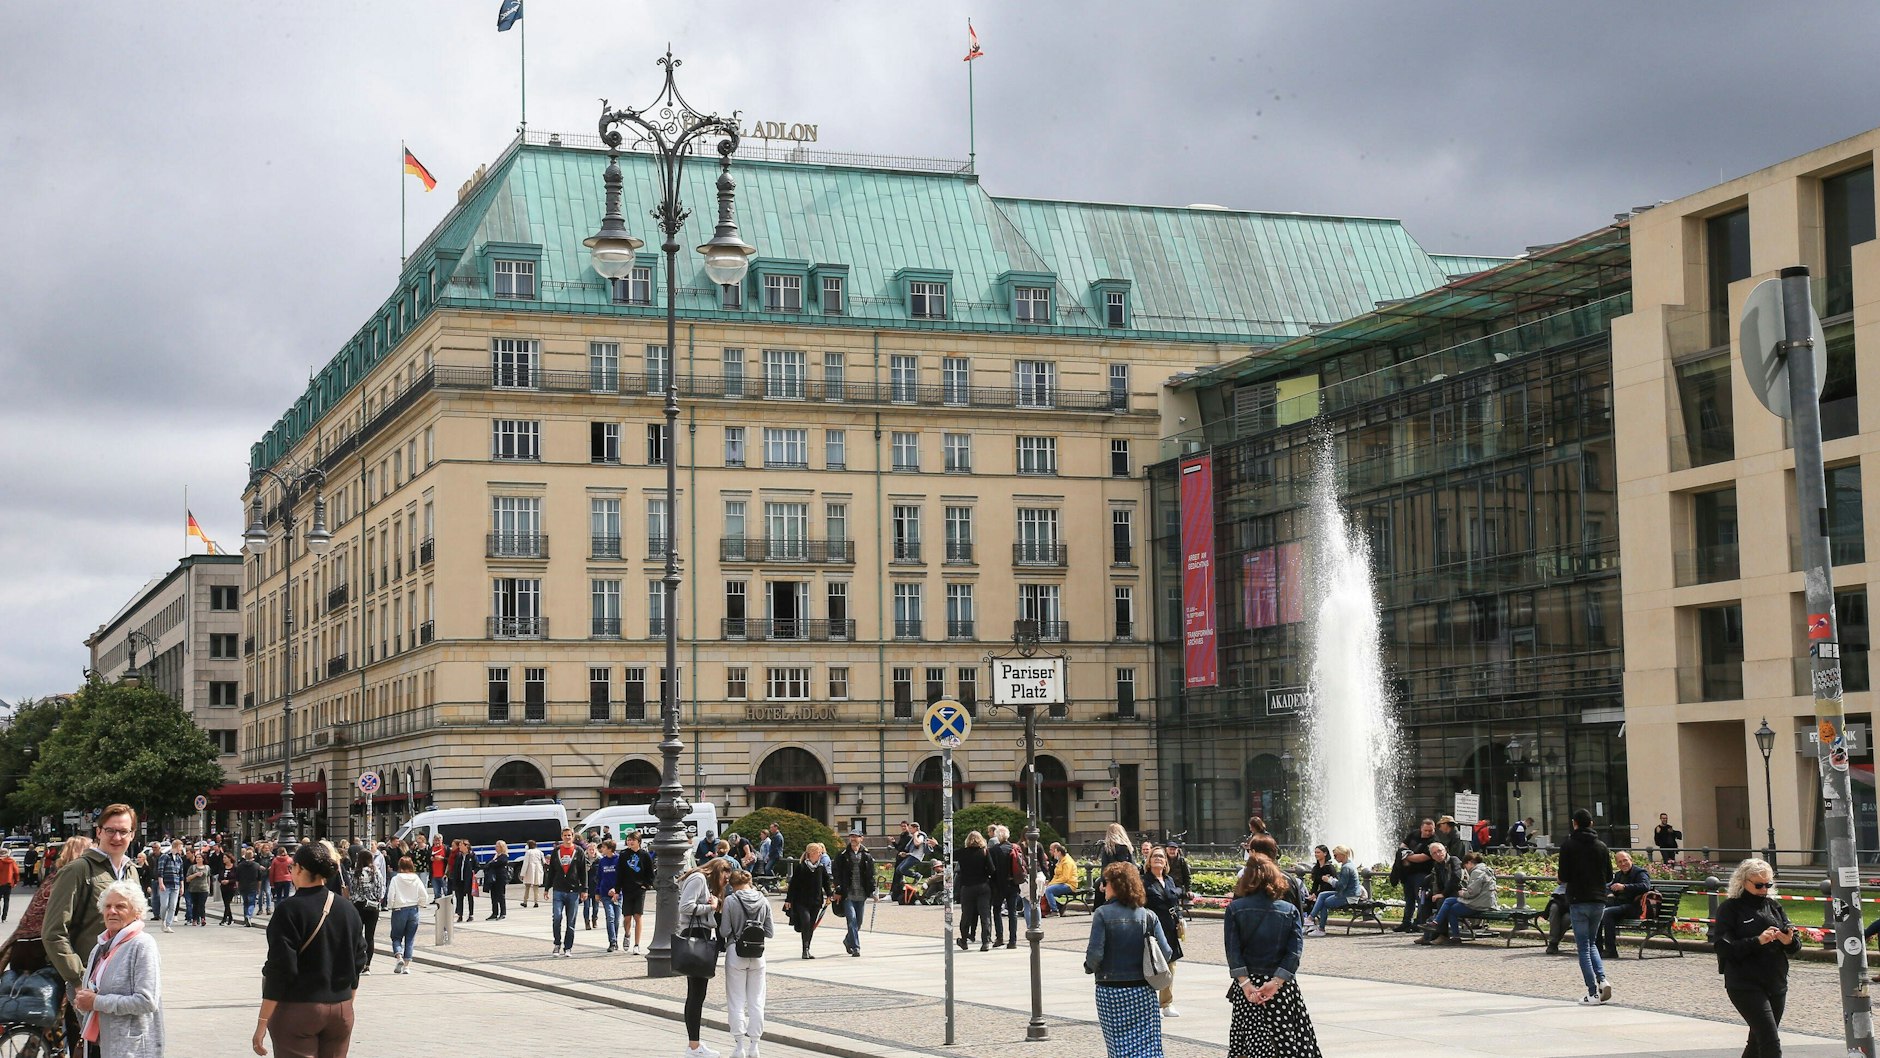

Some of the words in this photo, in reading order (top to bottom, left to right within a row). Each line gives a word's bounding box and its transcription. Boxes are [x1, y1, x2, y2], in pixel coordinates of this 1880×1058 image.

[752, 120, 818, 142] ADLON
[1002, 664, 1055, 679] Pariser
[1011, 683, 1047, 698] Platz
[745, 707, 789, 720] HOTEL
[792, 706, 837, 720] ADLON
